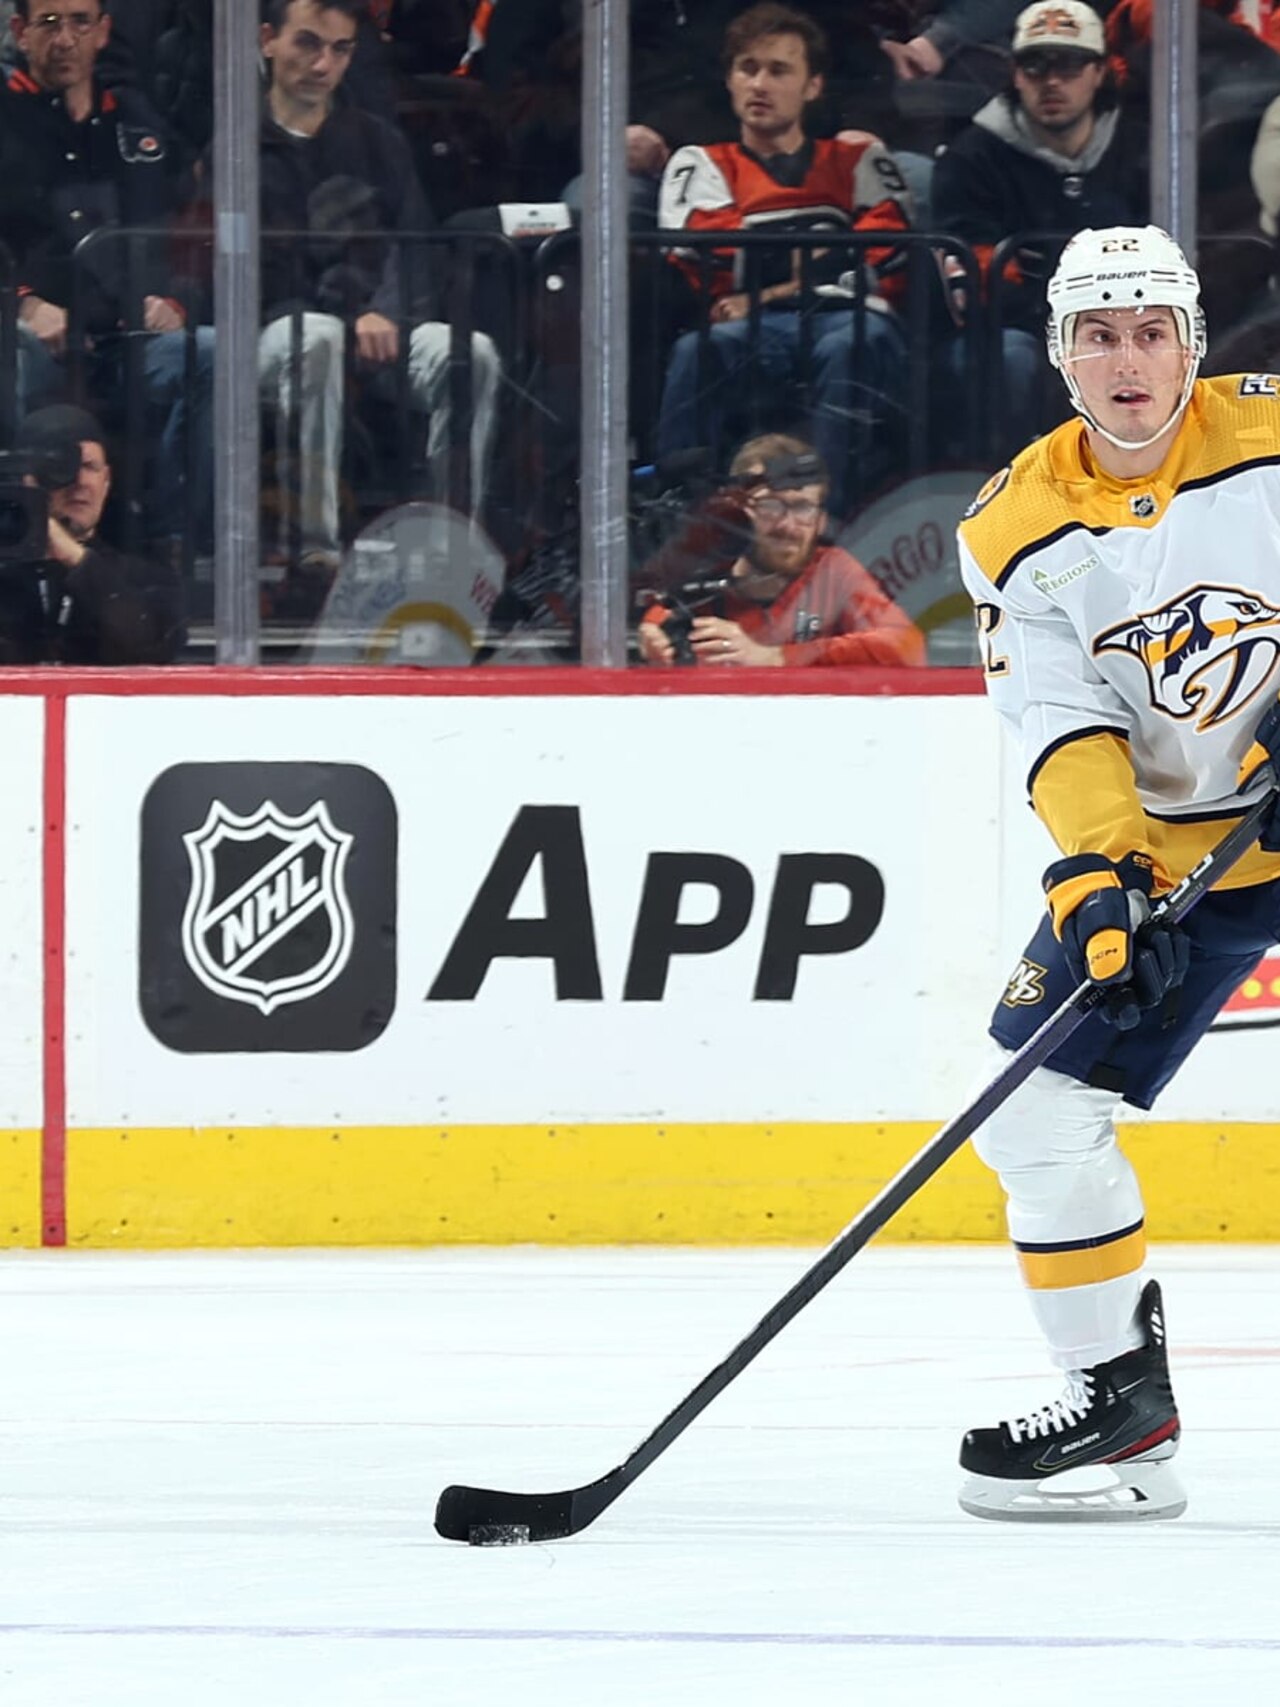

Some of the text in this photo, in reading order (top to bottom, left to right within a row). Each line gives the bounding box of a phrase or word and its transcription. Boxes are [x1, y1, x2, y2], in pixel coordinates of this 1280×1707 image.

[669, 165, 696, 205] 7
[1101, 239, 1140, 253] 22
[1096, 270, 1147, 282] BAUER
[1041, 556, 1099, 593] REGIONS
[221, 856, 320, 966] NHL
